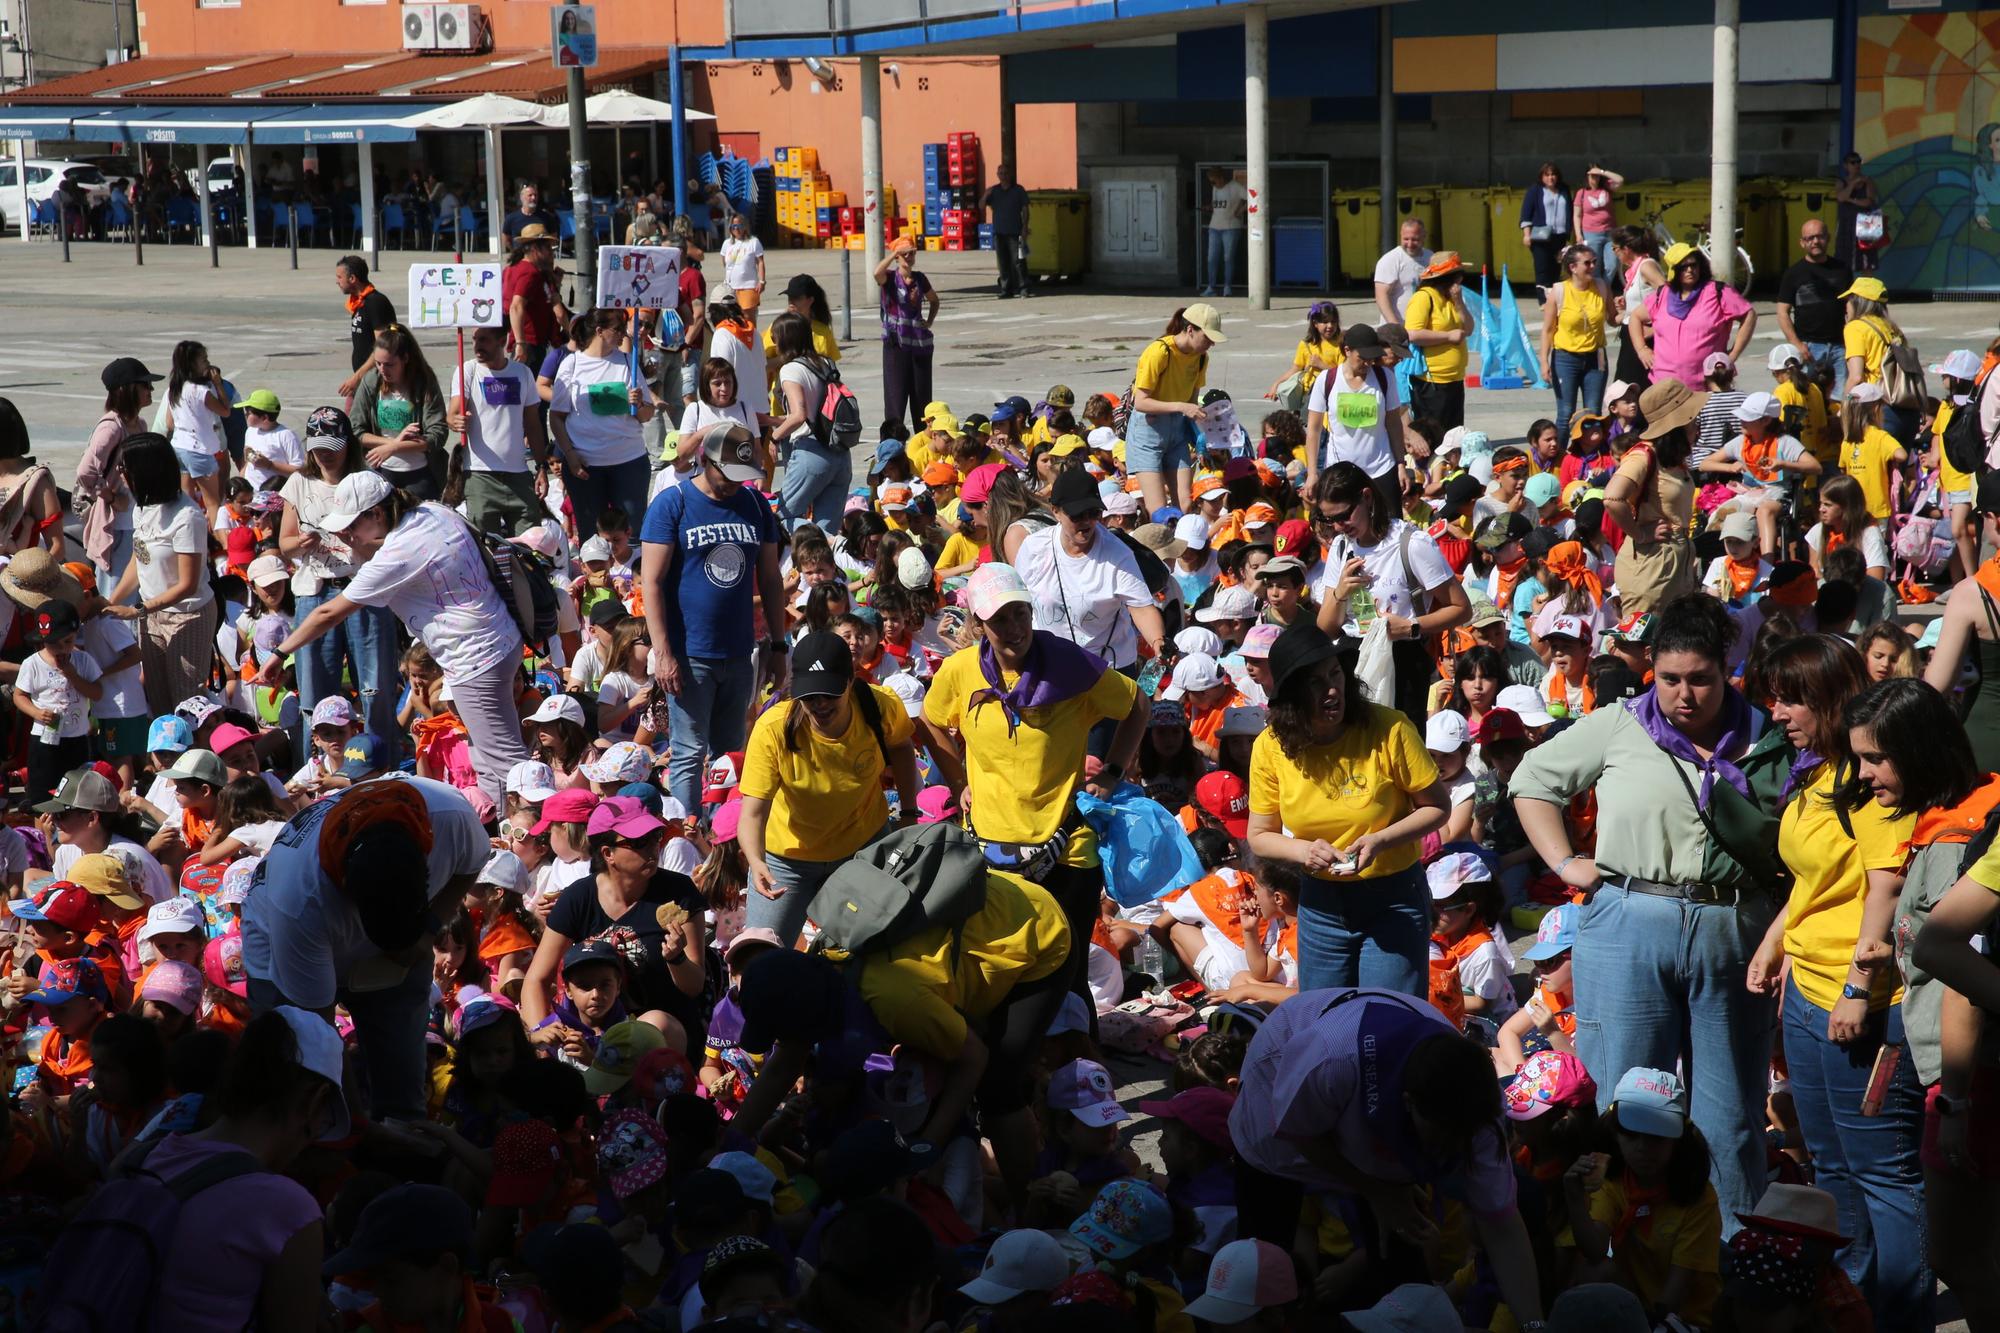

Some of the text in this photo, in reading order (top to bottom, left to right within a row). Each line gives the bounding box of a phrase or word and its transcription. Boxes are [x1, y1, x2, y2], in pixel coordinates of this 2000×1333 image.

[610, 253, 678, 274] BOTA A
[685, 522, 761, 549] FESTIVAL
[1635, 1077, 1675, 1099] Paula
